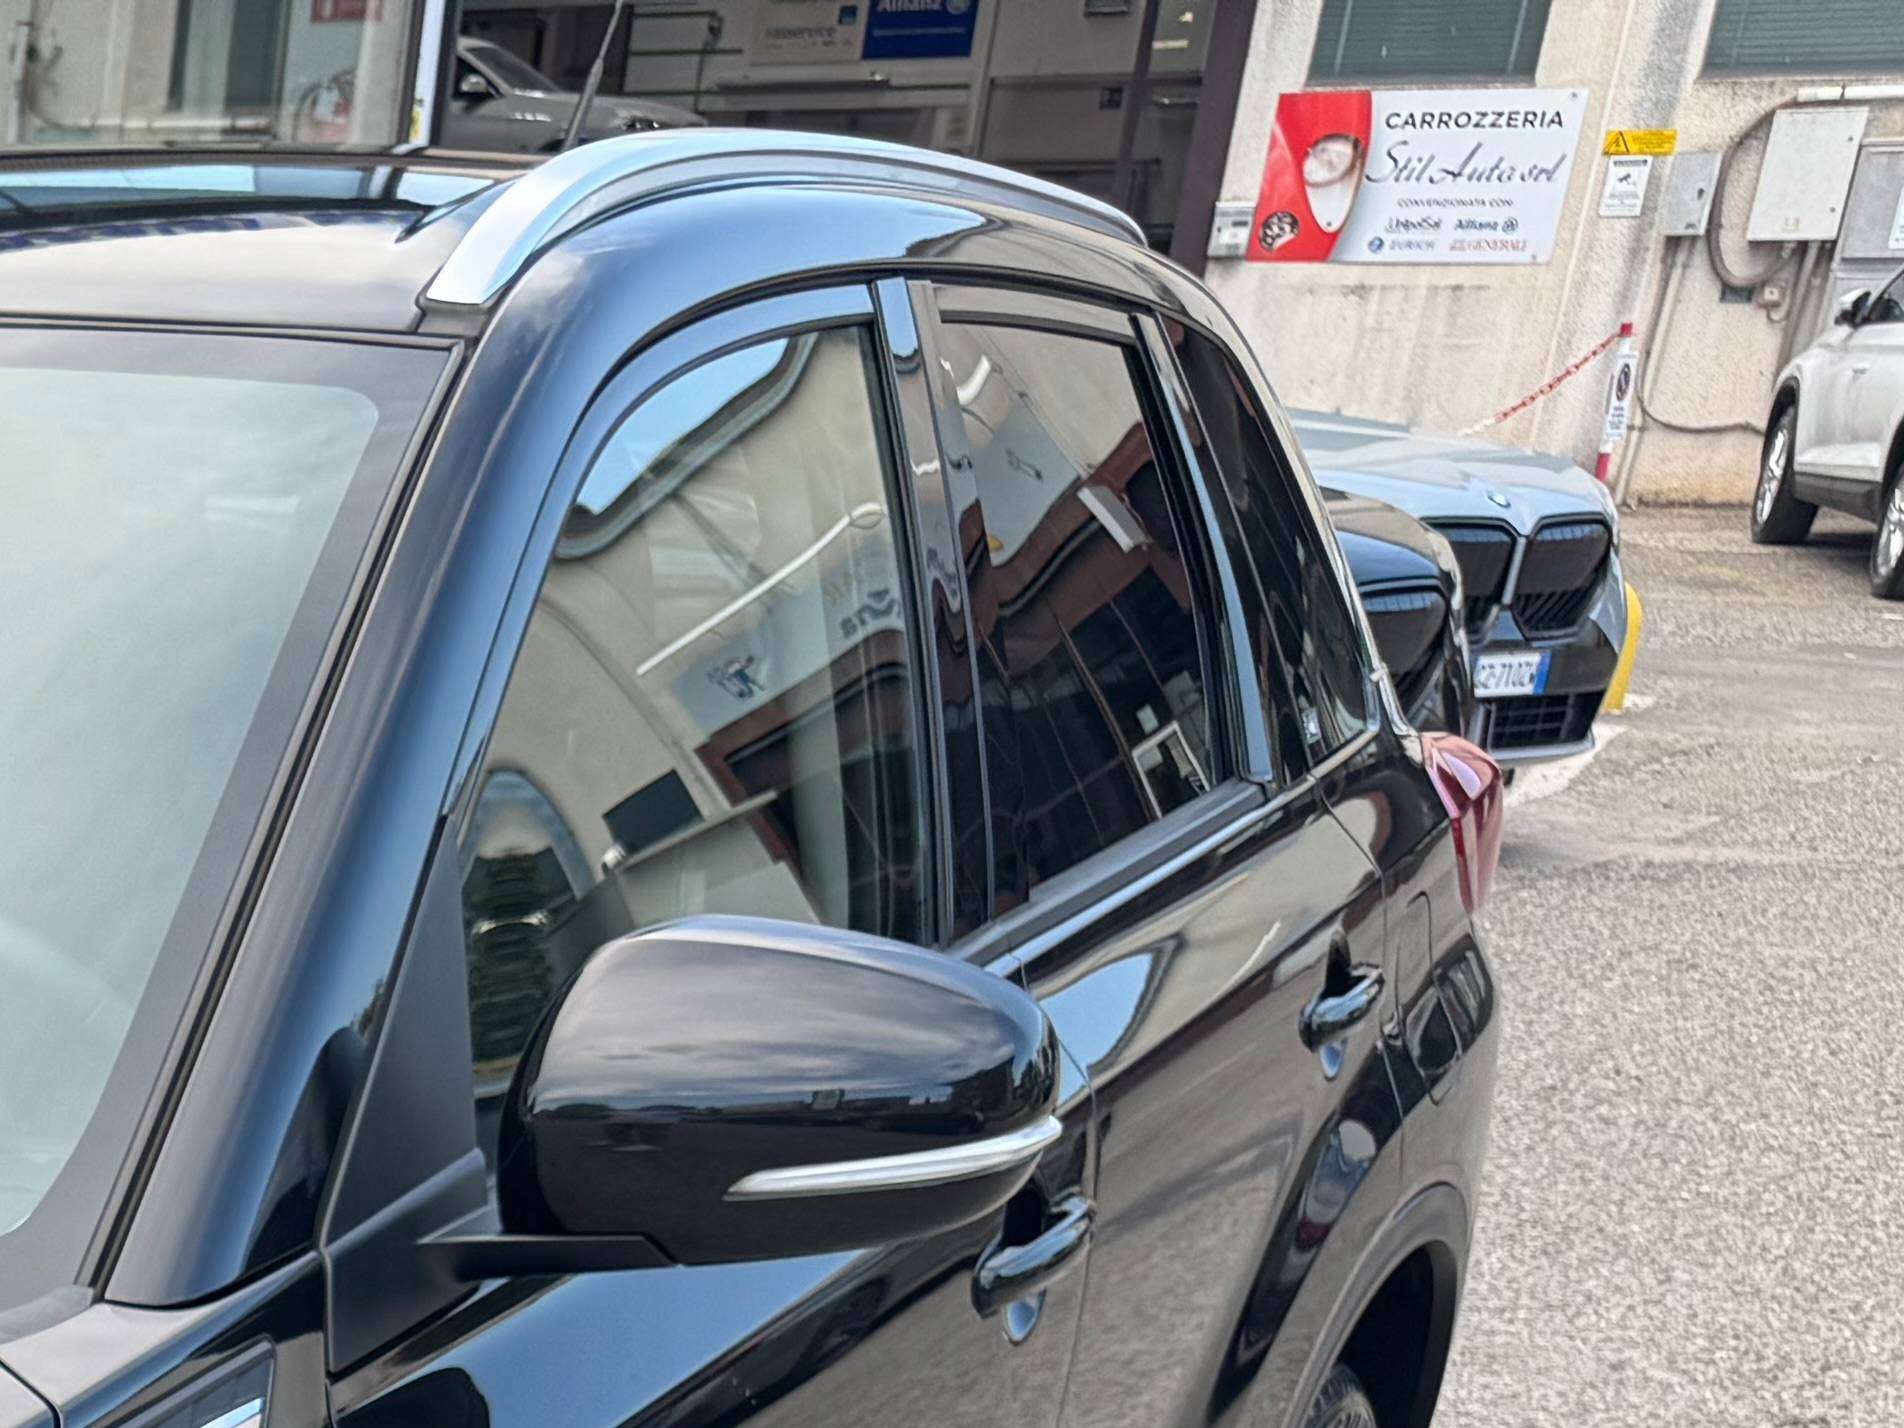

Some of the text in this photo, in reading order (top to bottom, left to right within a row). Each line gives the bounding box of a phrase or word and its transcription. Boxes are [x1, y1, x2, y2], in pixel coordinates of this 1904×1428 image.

[1385, 110, 1564, 130] CARROZZERIA
[1364, 139, 1436, 184] Stil
[1428, 140, 1516, 185] Auto
